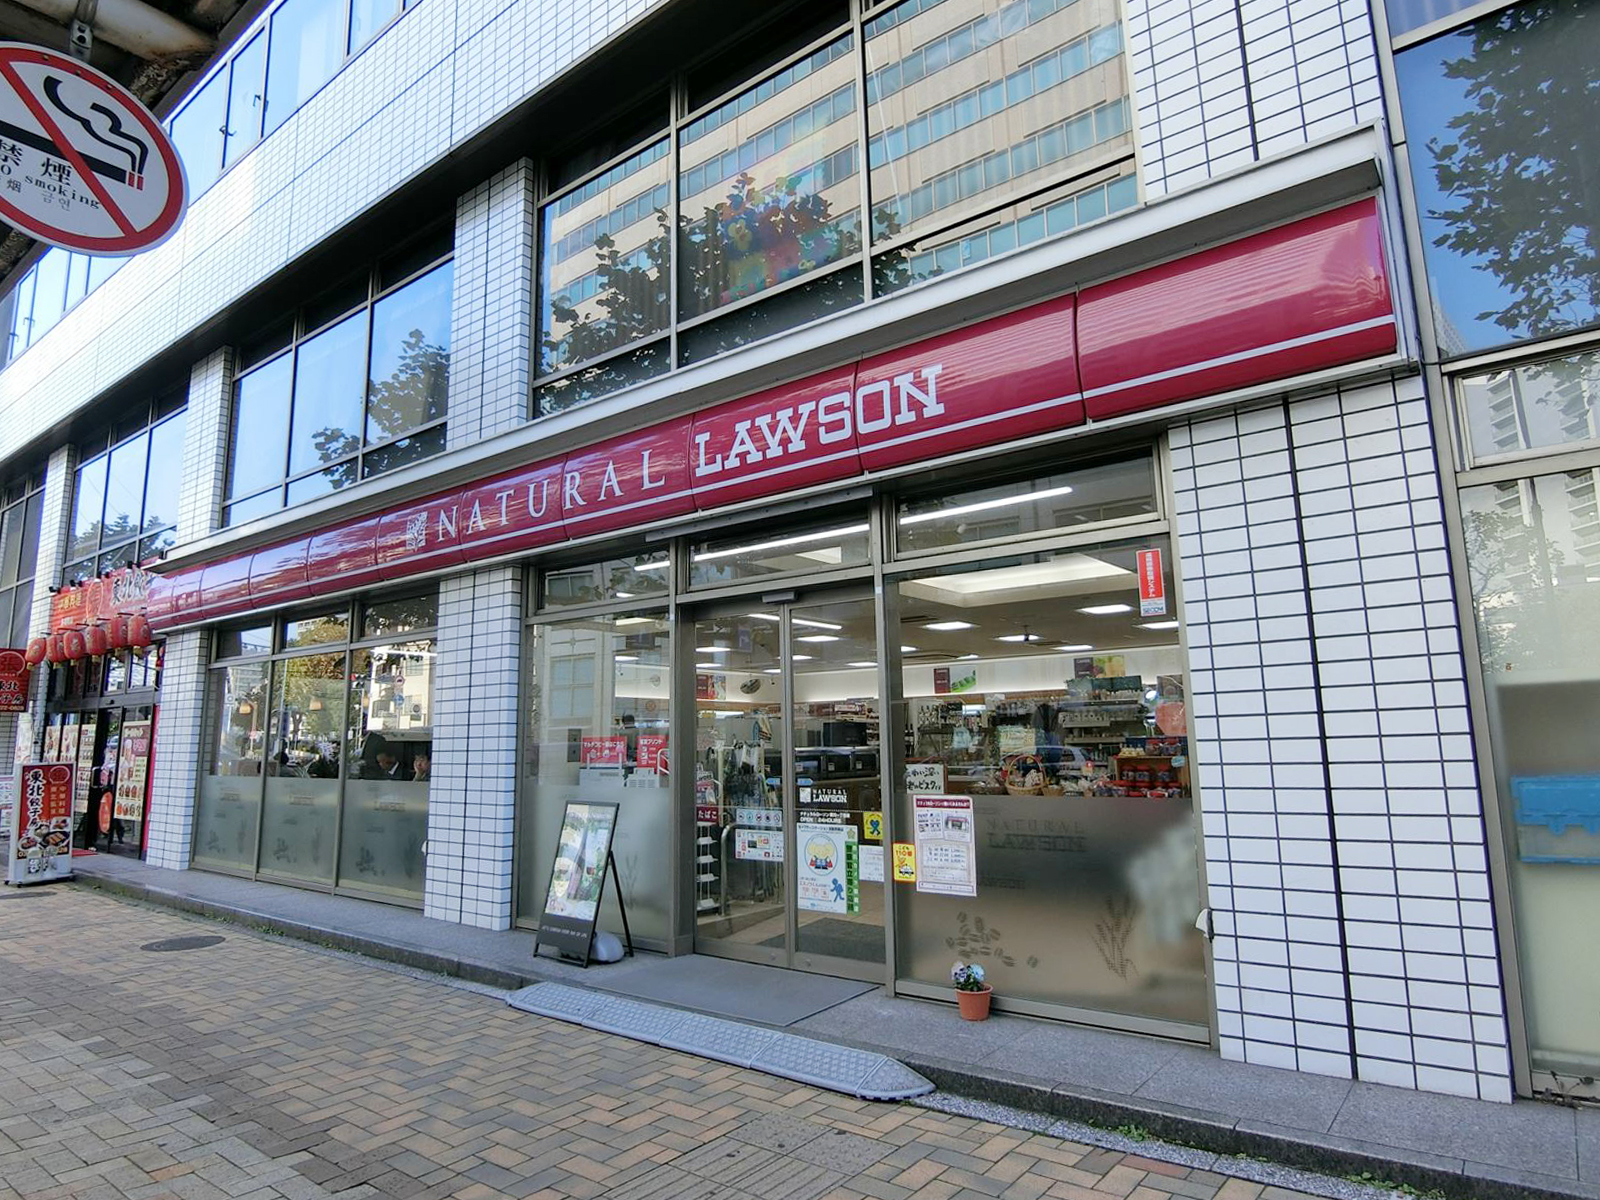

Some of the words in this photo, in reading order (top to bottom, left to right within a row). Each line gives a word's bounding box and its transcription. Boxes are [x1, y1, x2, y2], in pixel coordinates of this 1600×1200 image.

[24, 175, 100, 209] smoking
[437, 449, 666, 542] NATURAL
[694, 363, 945, 478] LAWSON
[812, 794, 848, 803] LAWSON
[698, 810, 717, 819] たばこ
